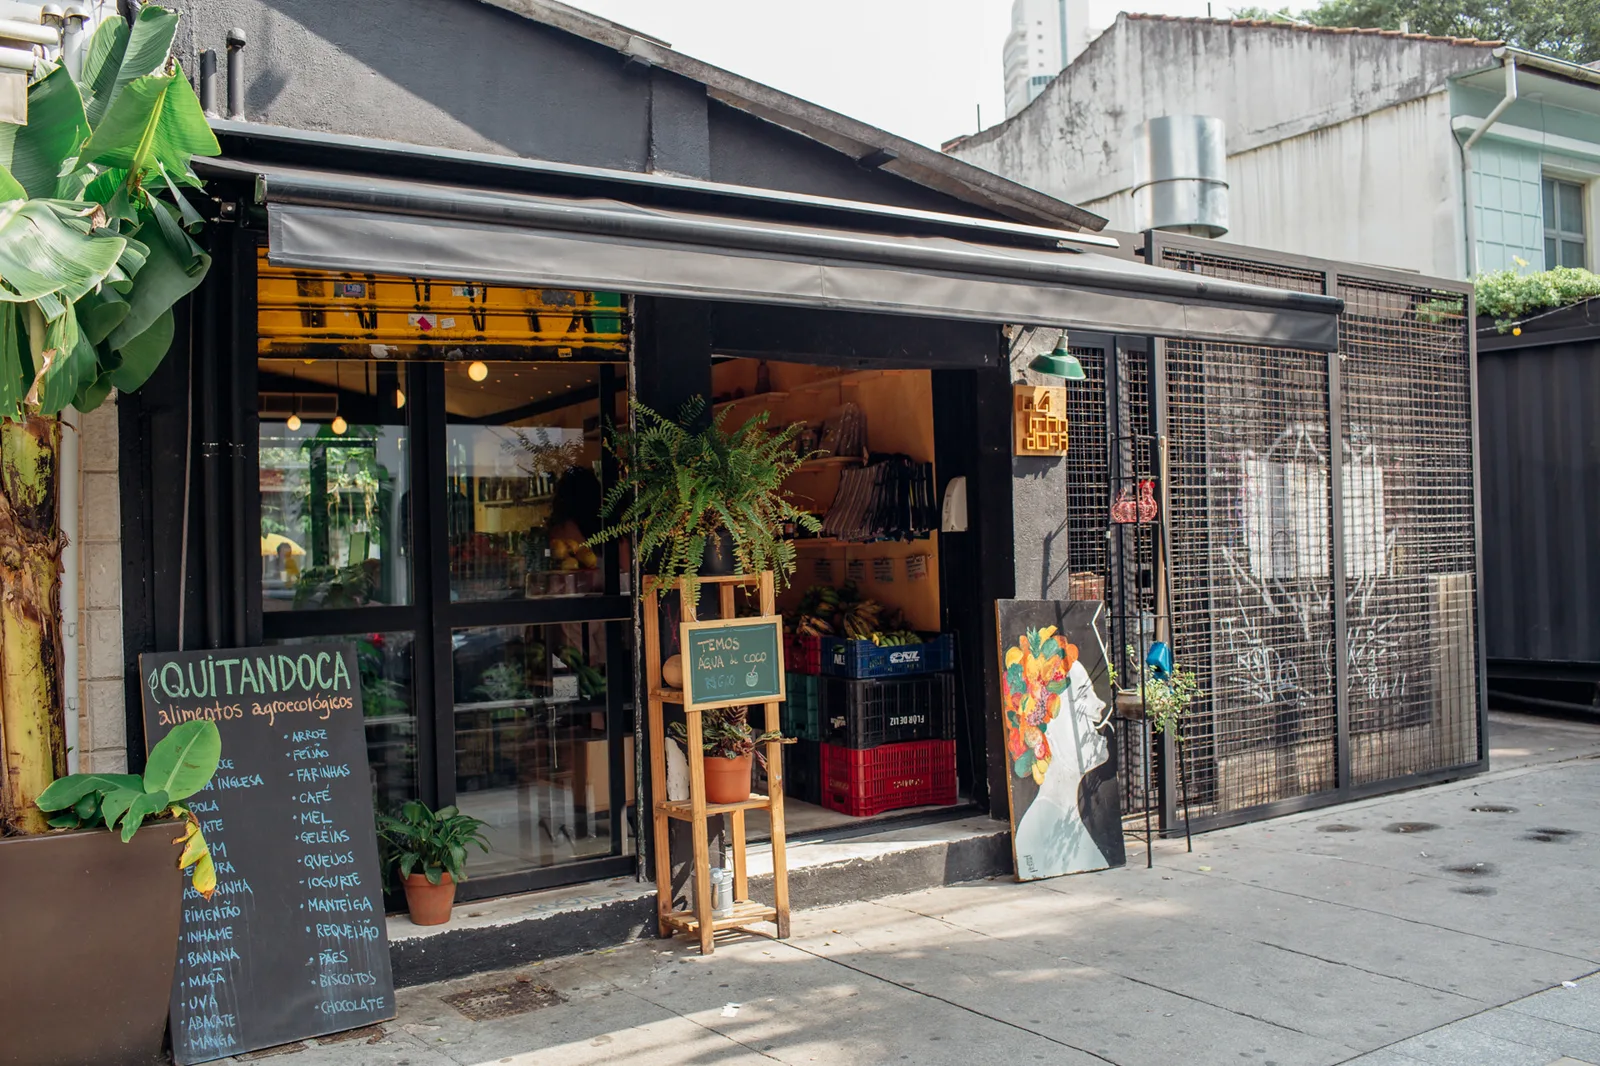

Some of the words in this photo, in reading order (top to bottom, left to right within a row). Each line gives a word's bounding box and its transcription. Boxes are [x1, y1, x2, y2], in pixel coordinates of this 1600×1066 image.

[697, 637, 740, 653] TEMOS
[697, 654, 725, 670] ÁGUA
[743, 651, 767, 663] COCO
[158, 700, 243, 726] alimentos
[251, 692, 353, 726] agroecológicos
[292, 729, 328, 743] ARROZ
[216, 758, 235, 770] OCE
[299, 783, 332, 804] CAFÉ
[188, 800, 219, 813] BOLA
[301, 811, 333, 825] MEL
[308, 872, 362, 889] IOGURTE
[187, 926, 233, 943] INHAME
[188, 947, 241, 968] BANANA
[189, 994, 218, 1010] UVA
[321, 996, 385, 1015] CHOCOLATE
[188, 1014, 236, 1031] ABACATE
[190, 1033, 237, 1050] MANGA
